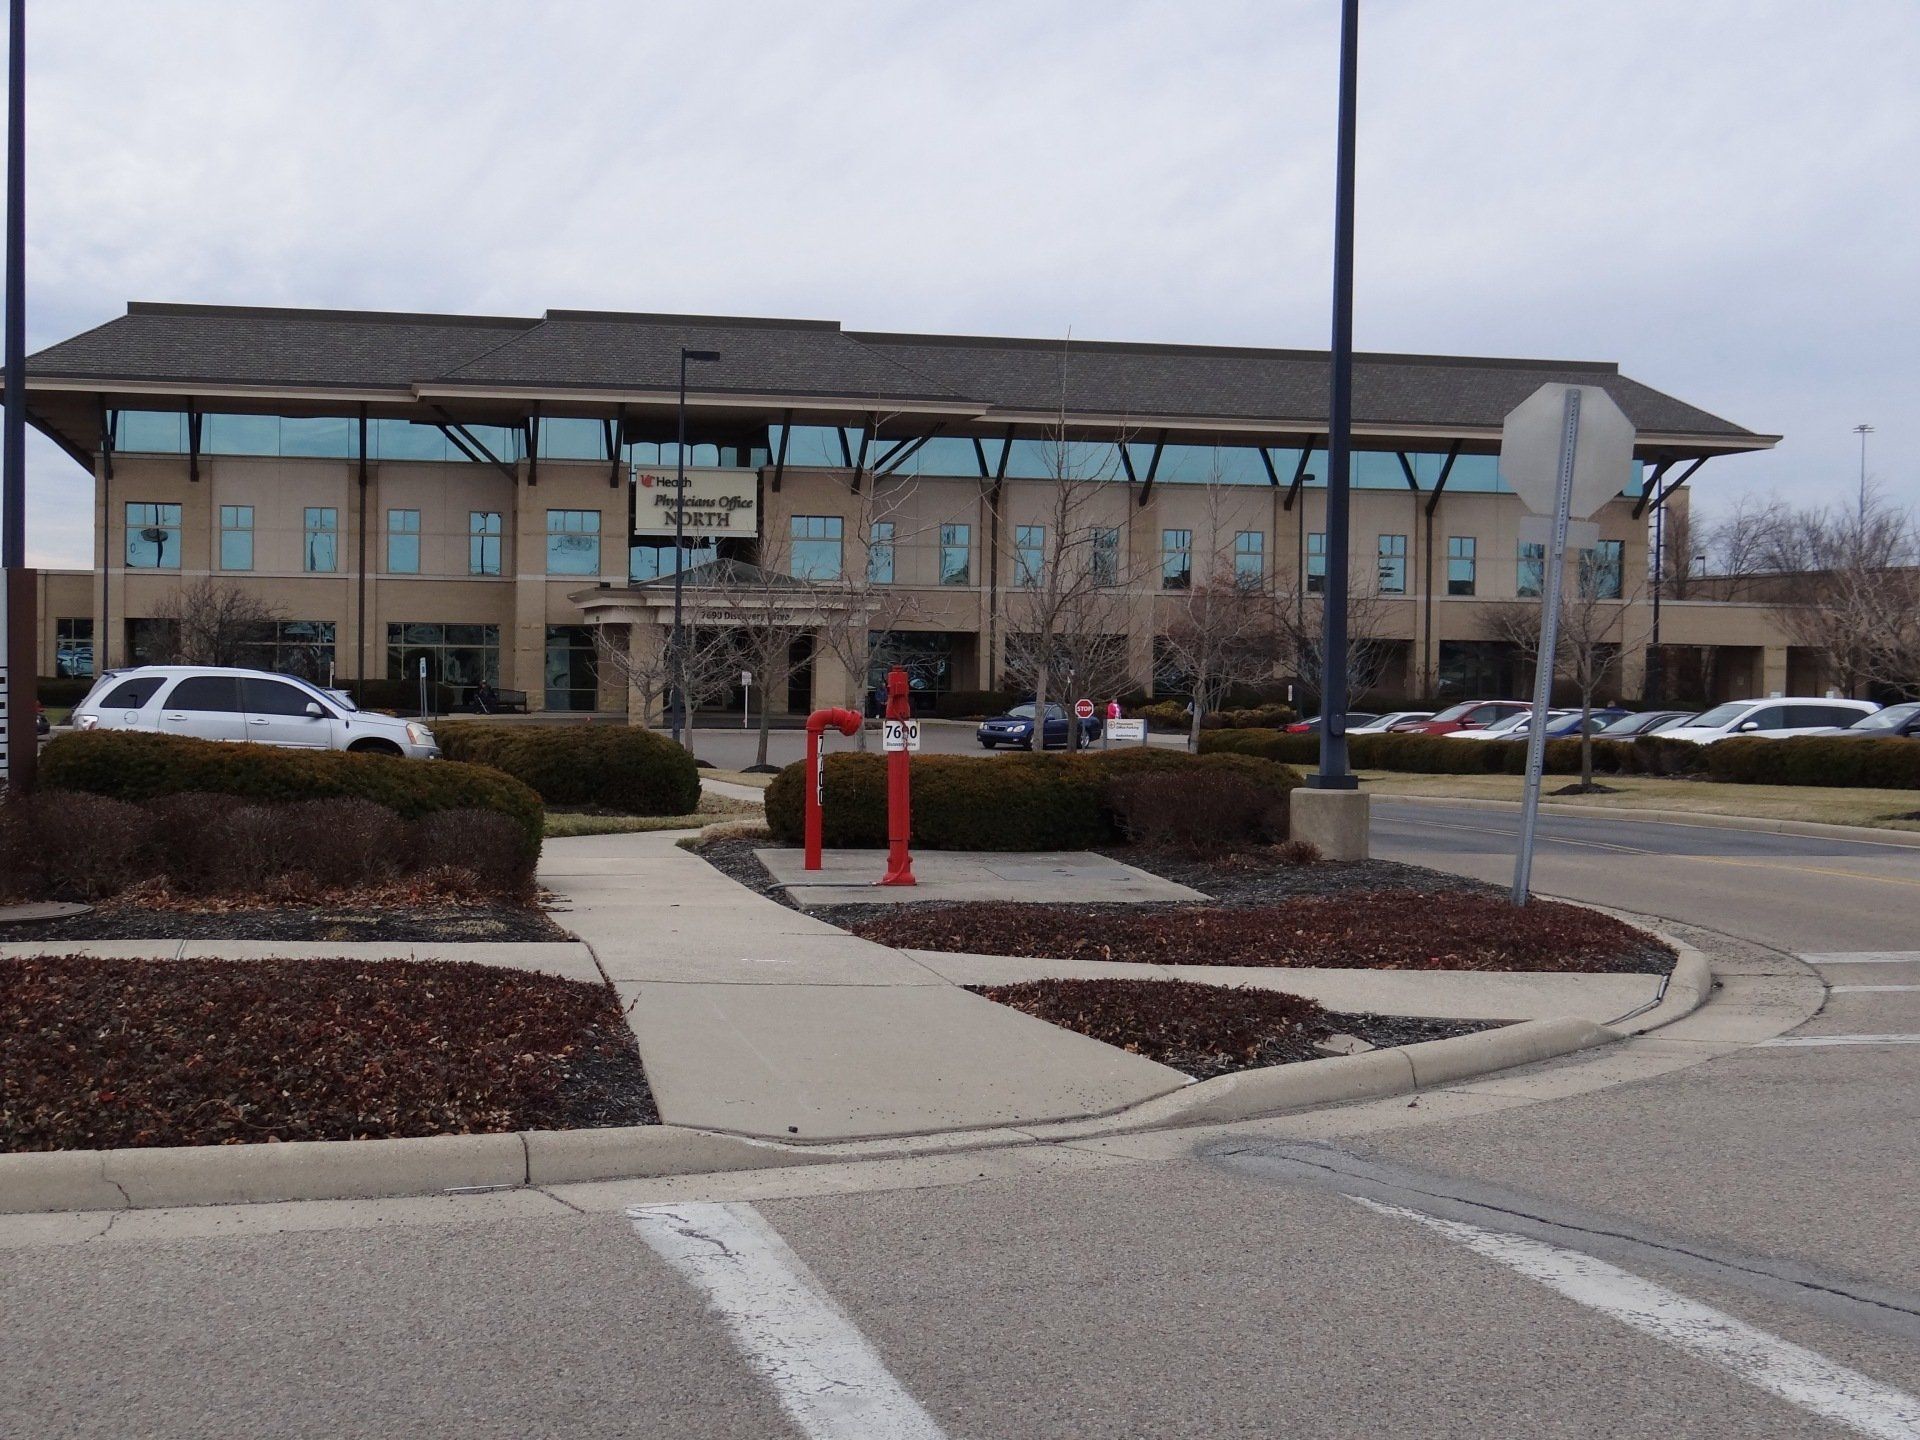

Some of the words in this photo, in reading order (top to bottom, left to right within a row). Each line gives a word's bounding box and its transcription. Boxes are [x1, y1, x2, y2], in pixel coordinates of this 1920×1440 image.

[656, 476, 692, 488] Heah
[654, 494, 716, 510] Phyicians
[718, 495, 754, 511] Office
[664, 511, 731, 527] NORTH
[885, 725, 918, 739] 760
